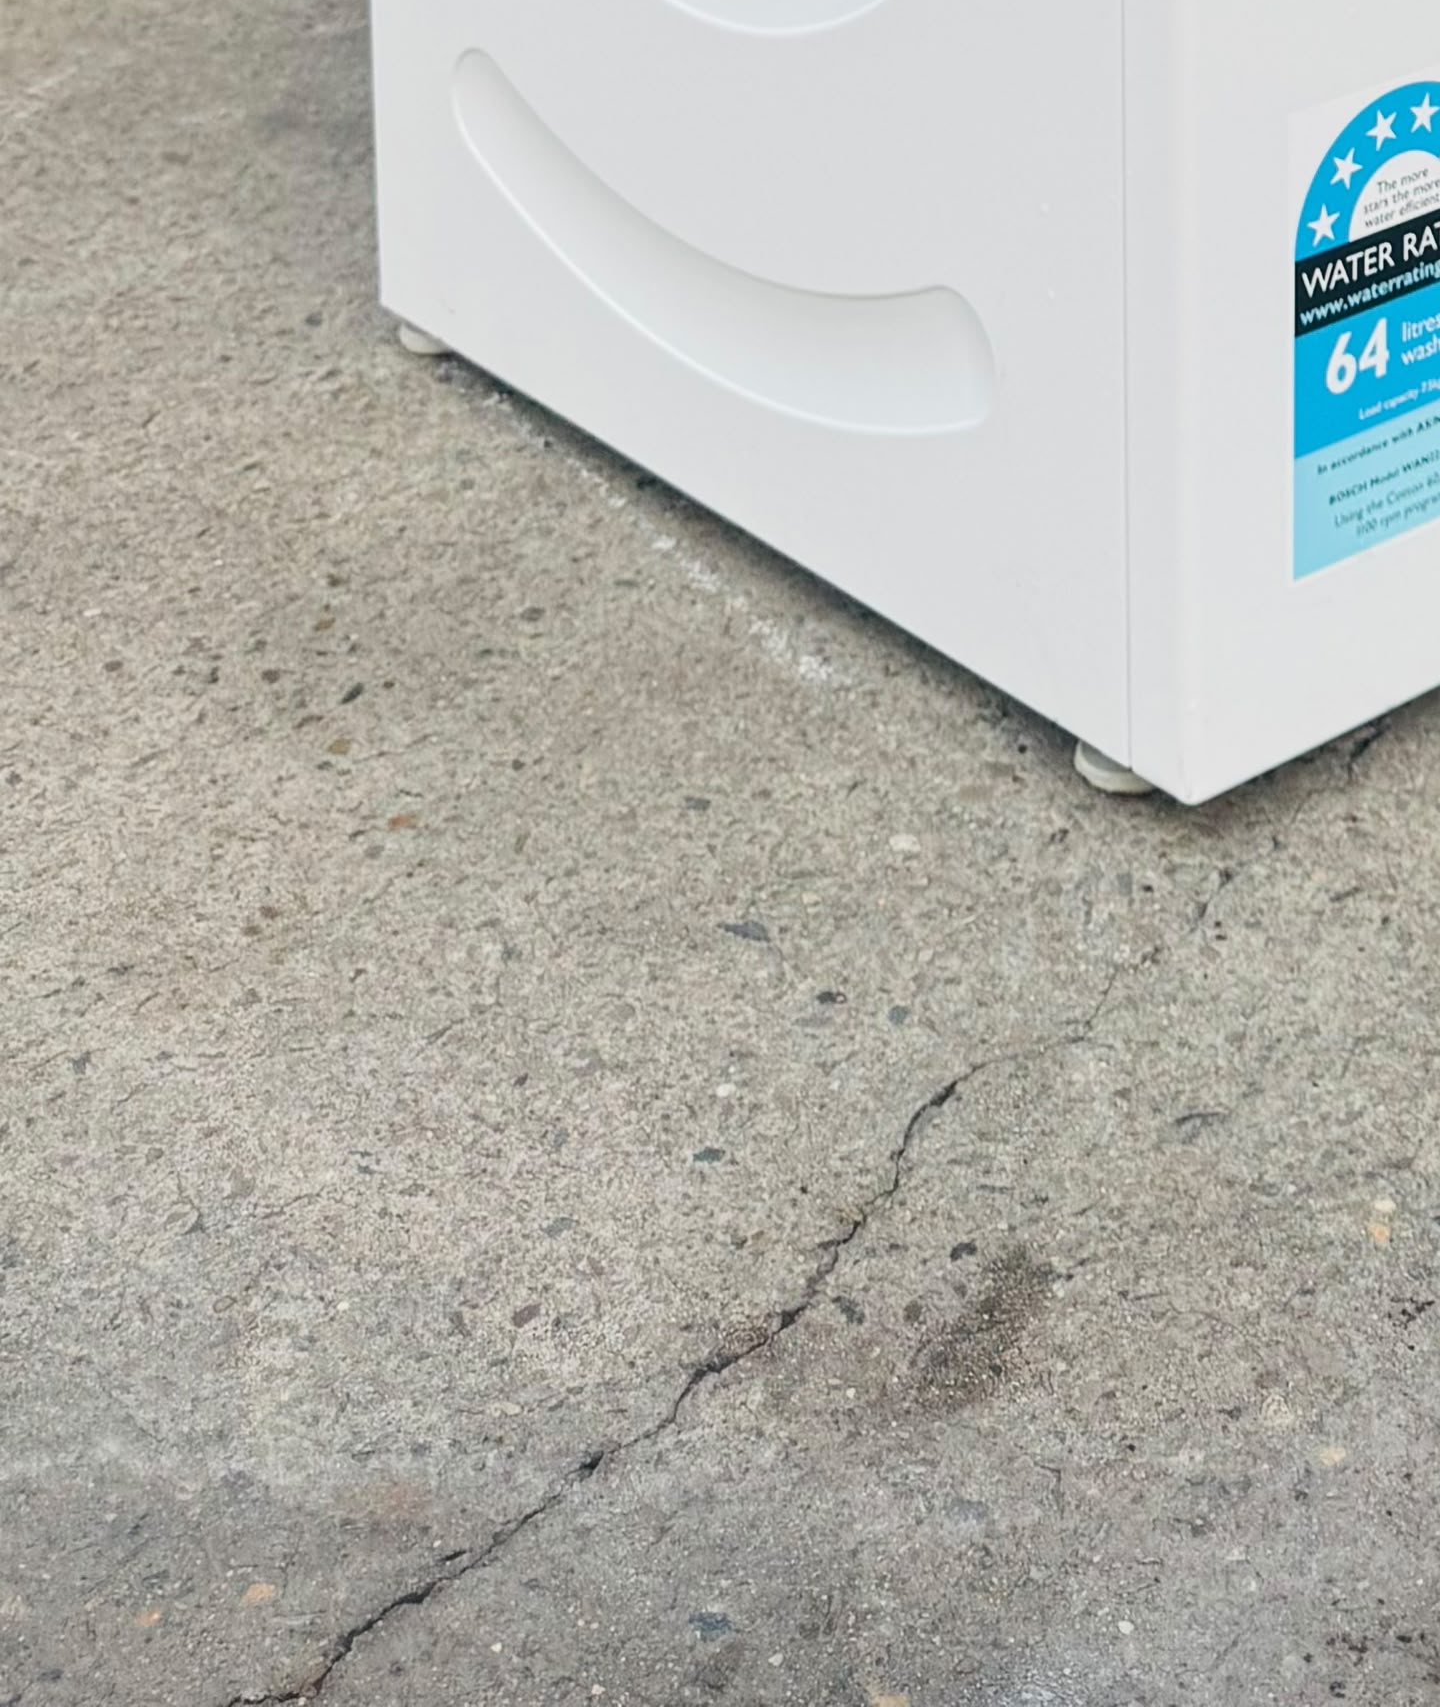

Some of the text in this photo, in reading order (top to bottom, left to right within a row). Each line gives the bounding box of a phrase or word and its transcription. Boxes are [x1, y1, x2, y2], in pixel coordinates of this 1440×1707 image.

[1377, 167, 1430, 194] The more
[1363, 197, 1390, 215] stars
[1392, 188, 1411, 207] the
[1365, 192, 1440, 228] water efficient
[1301, 241, 1395, 298] WATER
[1325, 317, 1390, 396] 64
